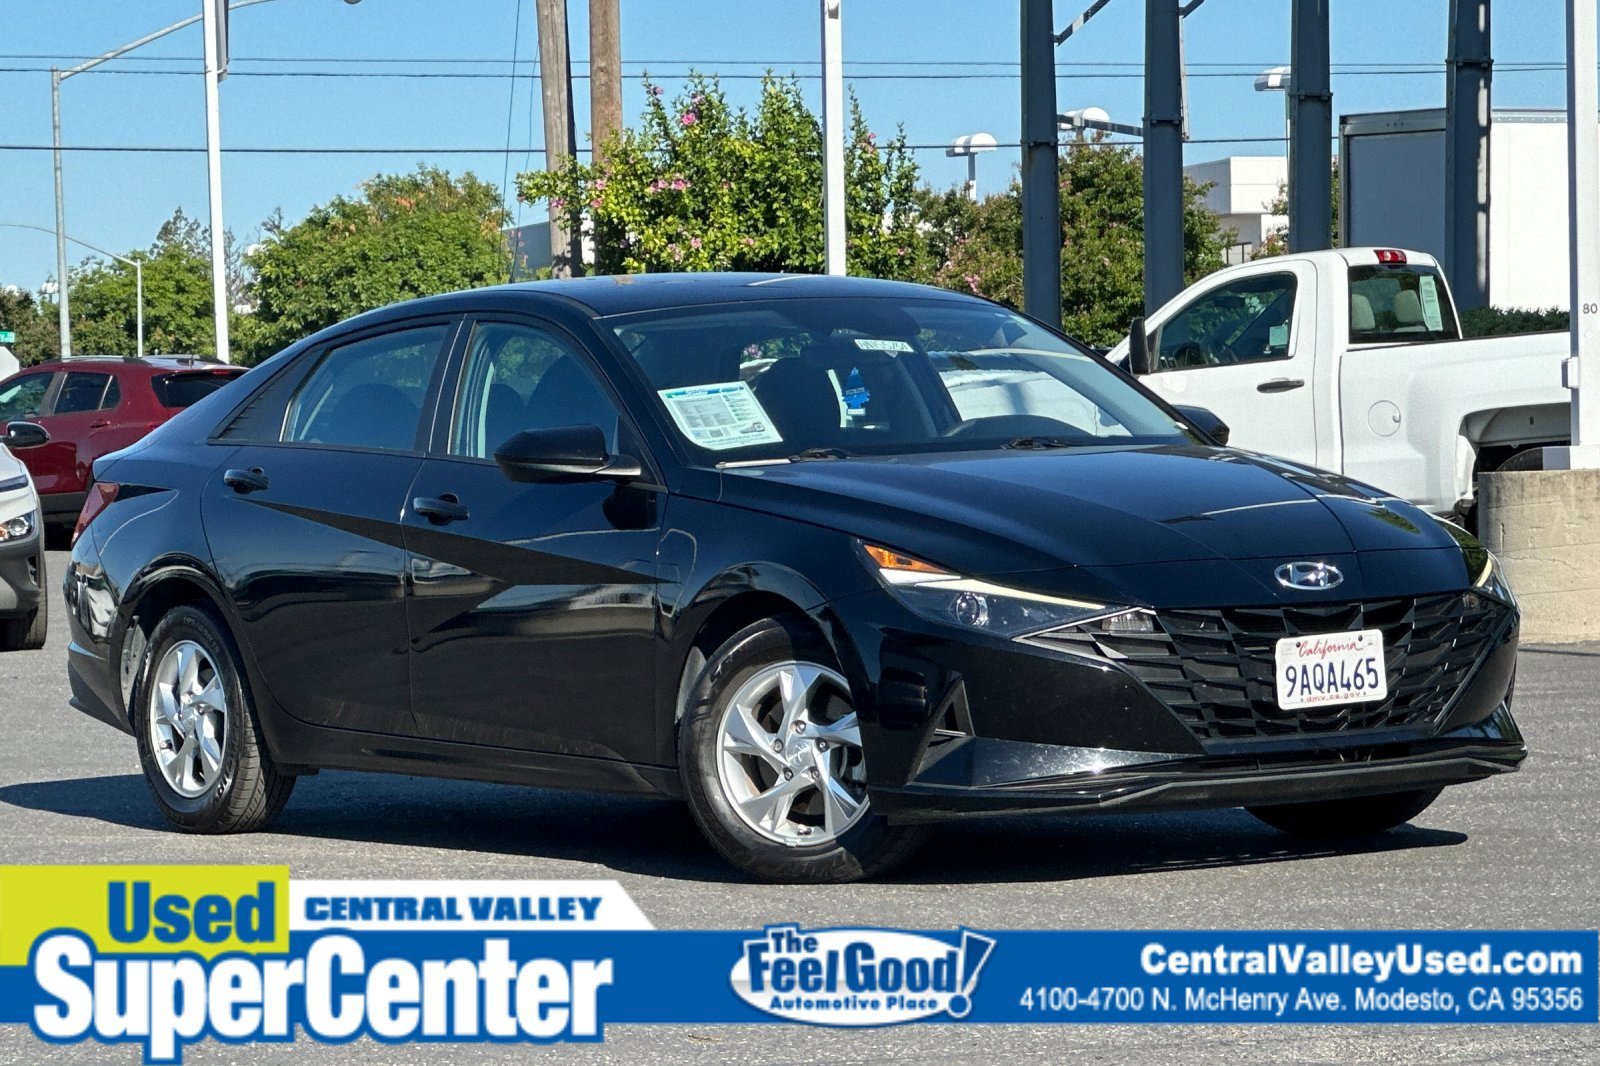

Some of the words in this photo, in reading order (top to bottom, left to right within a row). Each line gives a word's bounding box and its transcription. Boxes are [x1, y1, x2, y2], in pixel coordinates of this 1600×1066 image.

[1582, 303, 1598, 315] 80
[1298, 640, 1363, 659] California
[1285, 657, 1379, 698] 9AQA465
[1306, 691, 1361, 703] dmv.ca.gov
